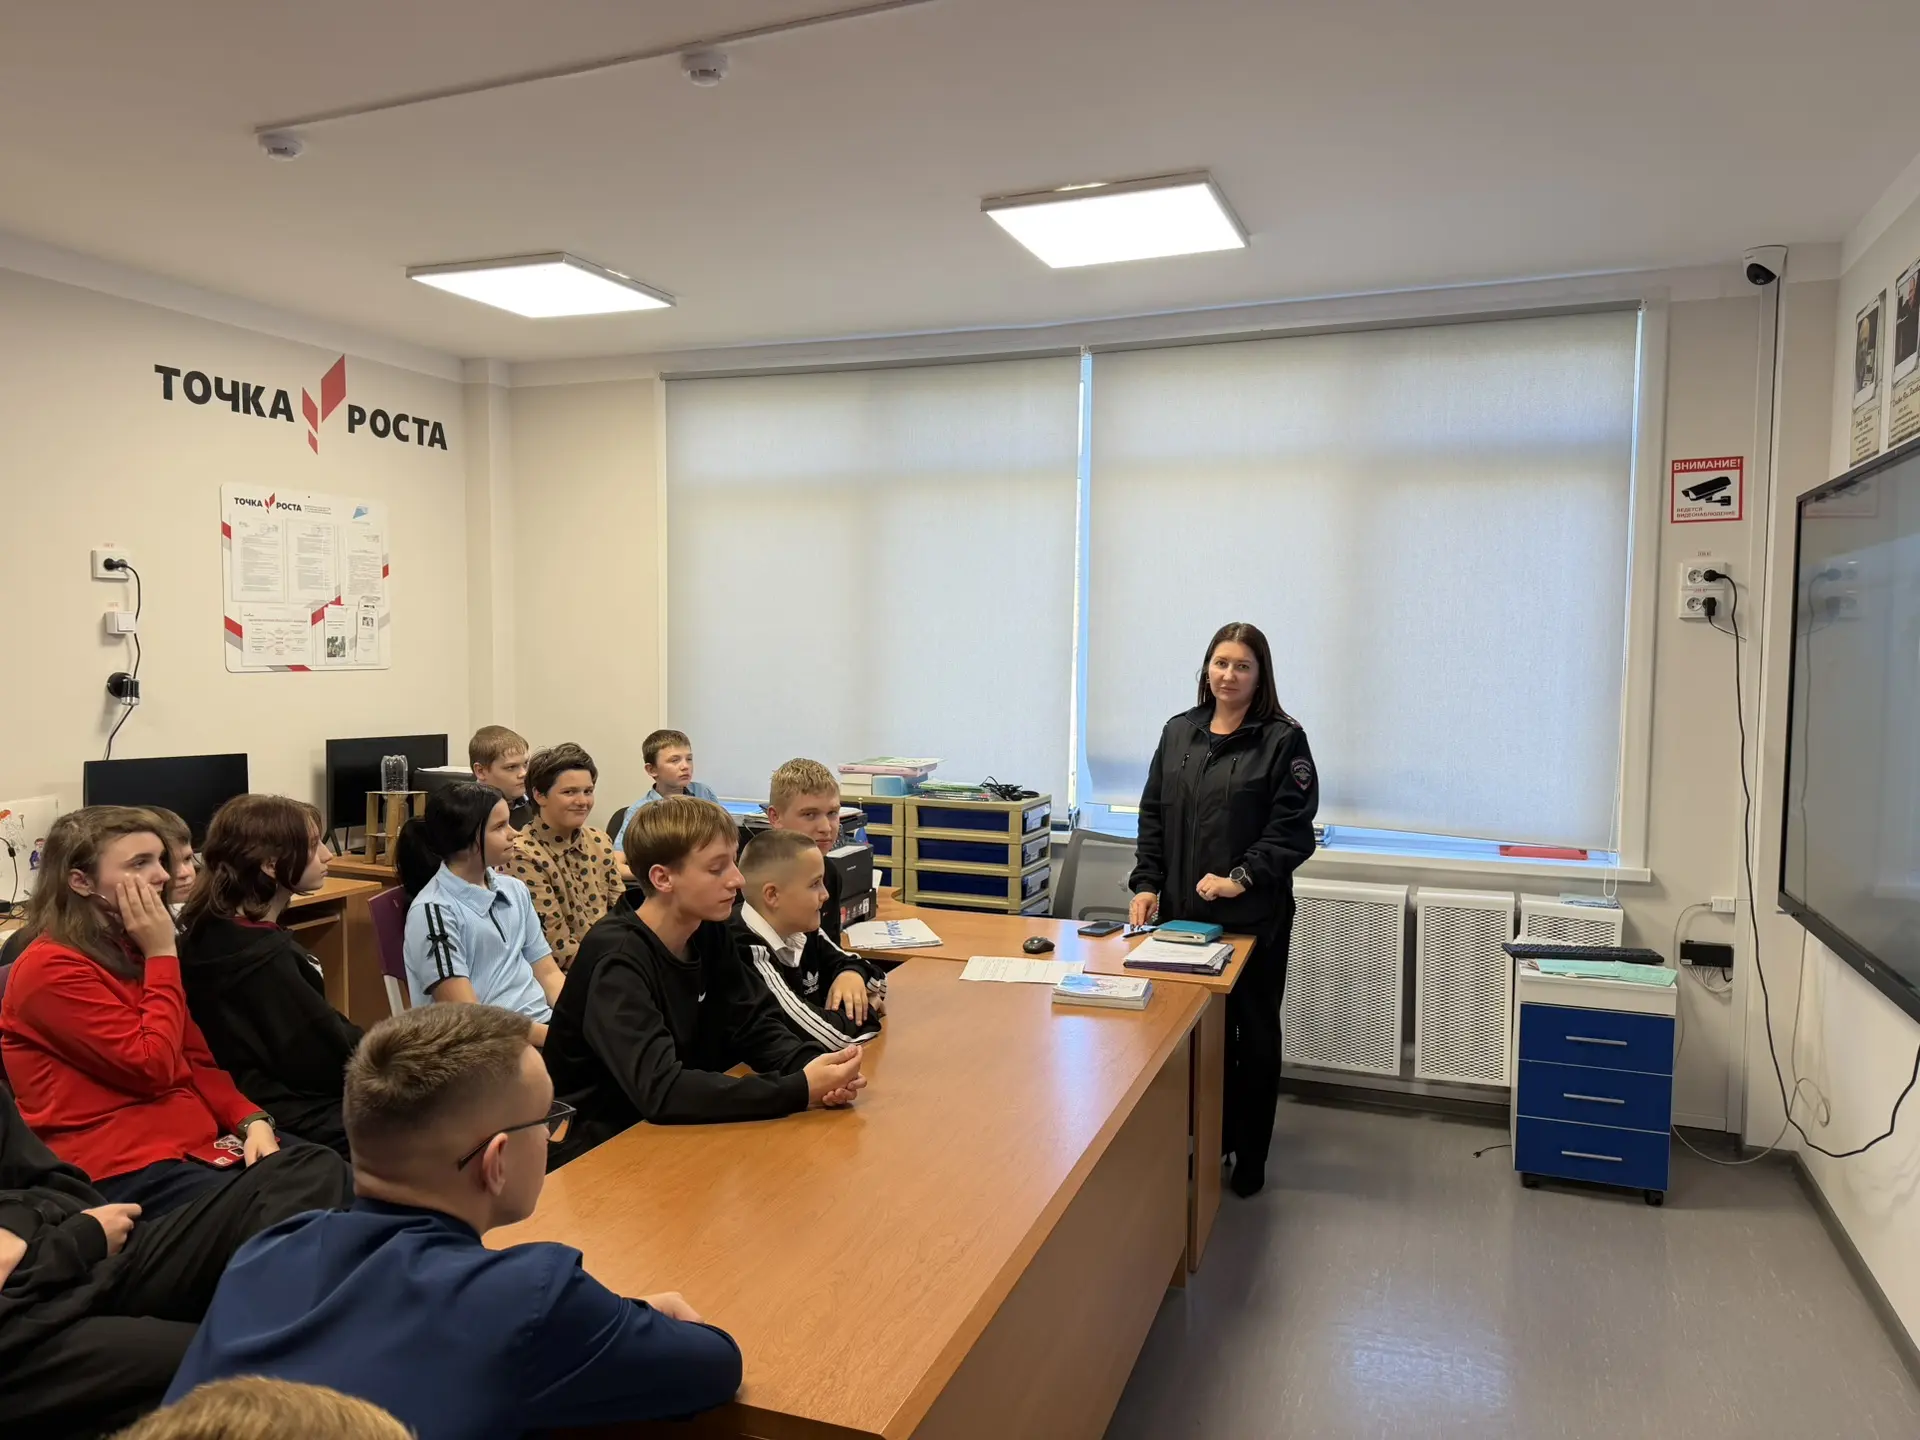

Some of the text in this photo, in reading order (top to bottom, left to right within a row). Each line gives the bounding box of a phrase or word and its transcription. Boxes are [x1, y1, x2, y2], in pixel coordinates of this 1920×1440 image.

[154, 364, 448, 451] ТОЧКА РОСТА
[1673, 459, 1740, 471] ВНИМАНИЕ!
[234, 497, 263, 508] ТОЧКА
[276, 502, 302, 512] РОСТА
